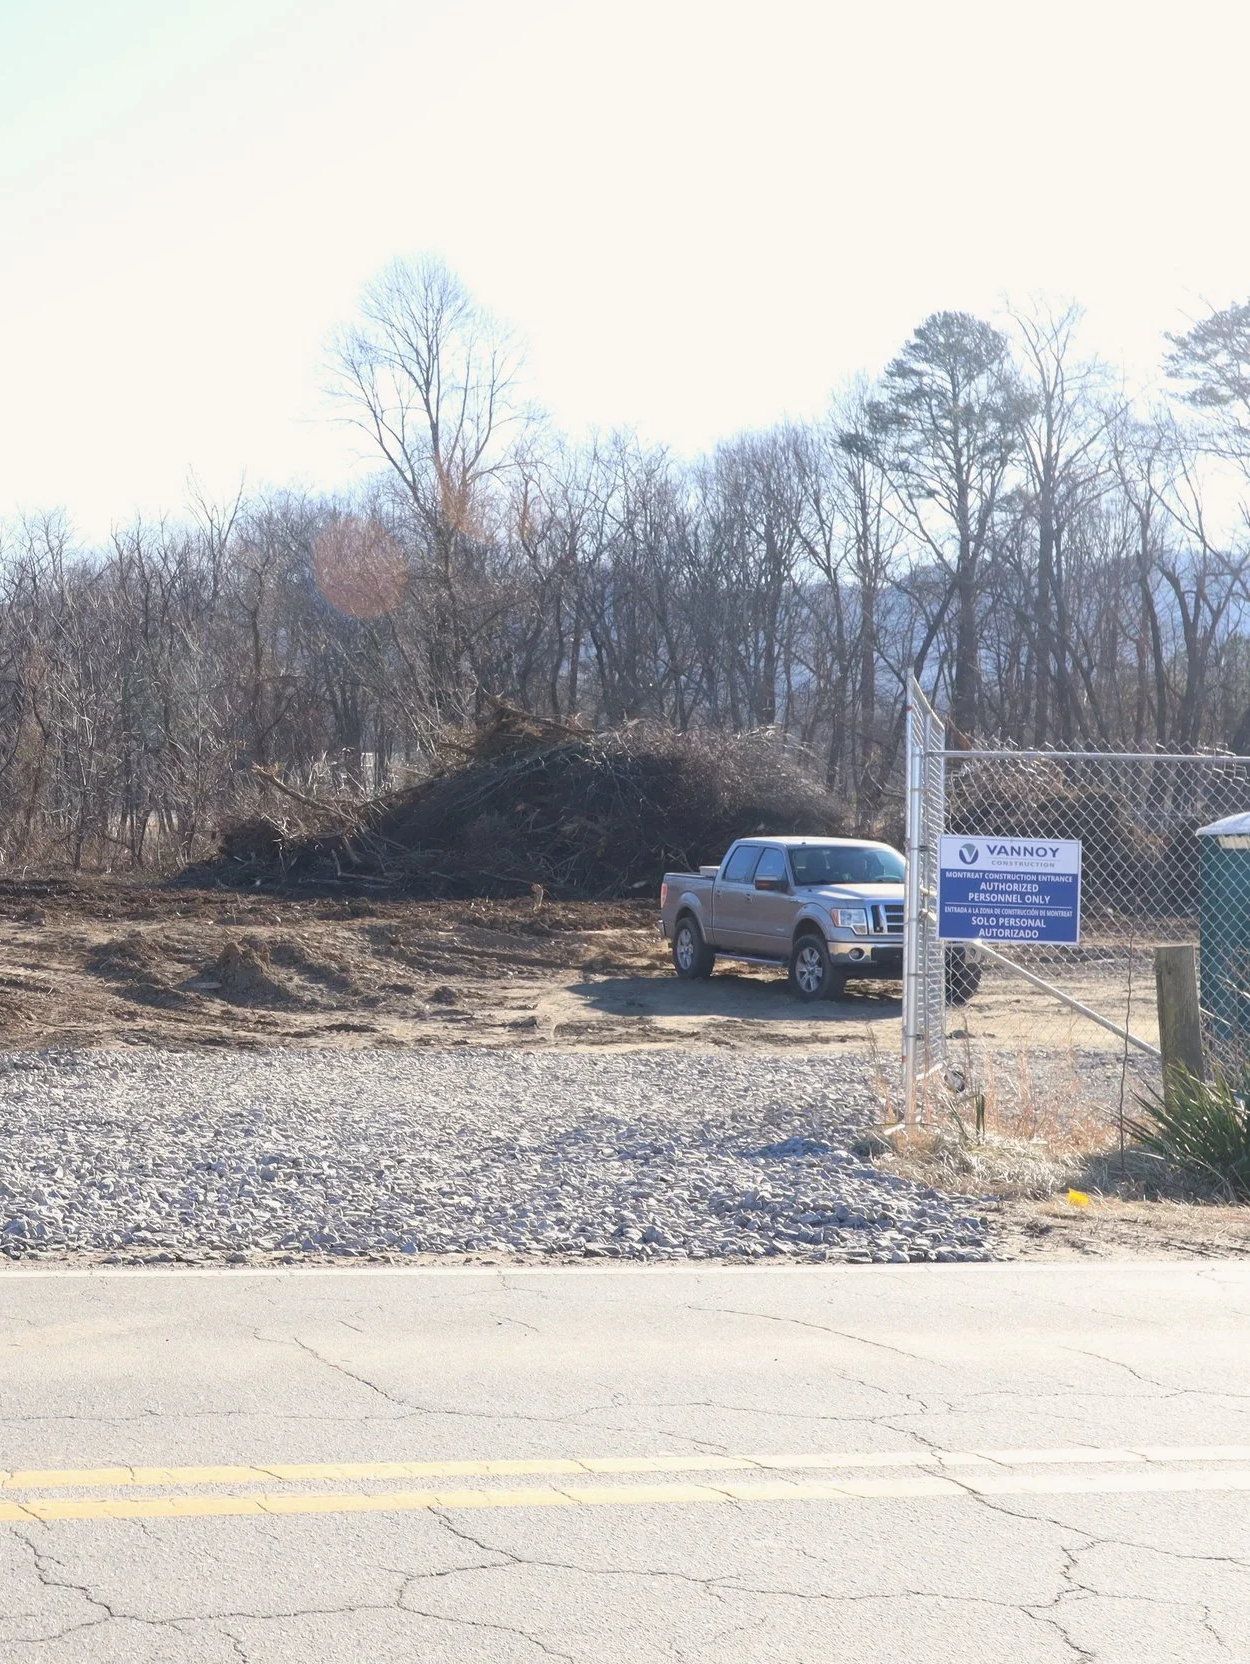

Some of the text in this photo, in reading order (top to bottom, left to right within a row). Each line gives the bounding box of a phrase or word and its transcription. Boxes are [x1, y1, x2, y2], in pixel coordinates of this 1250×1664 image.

[987, 845, 1060, 857] VANNOY
[991, 860, 1055, 868] CONSTRUCTION
[946, 871, 1073, 883] MONTREAT CONSTRUCTION ENTRANCE
[980, 882, 1039, 891] AUTHORIZED
[969, 894, 1051, 904] PERSONNEL ONLY
[972, 916, 1046, 927] SOLO PERSONAL
[979, 928, 1039, 938] AUTORIZADO
